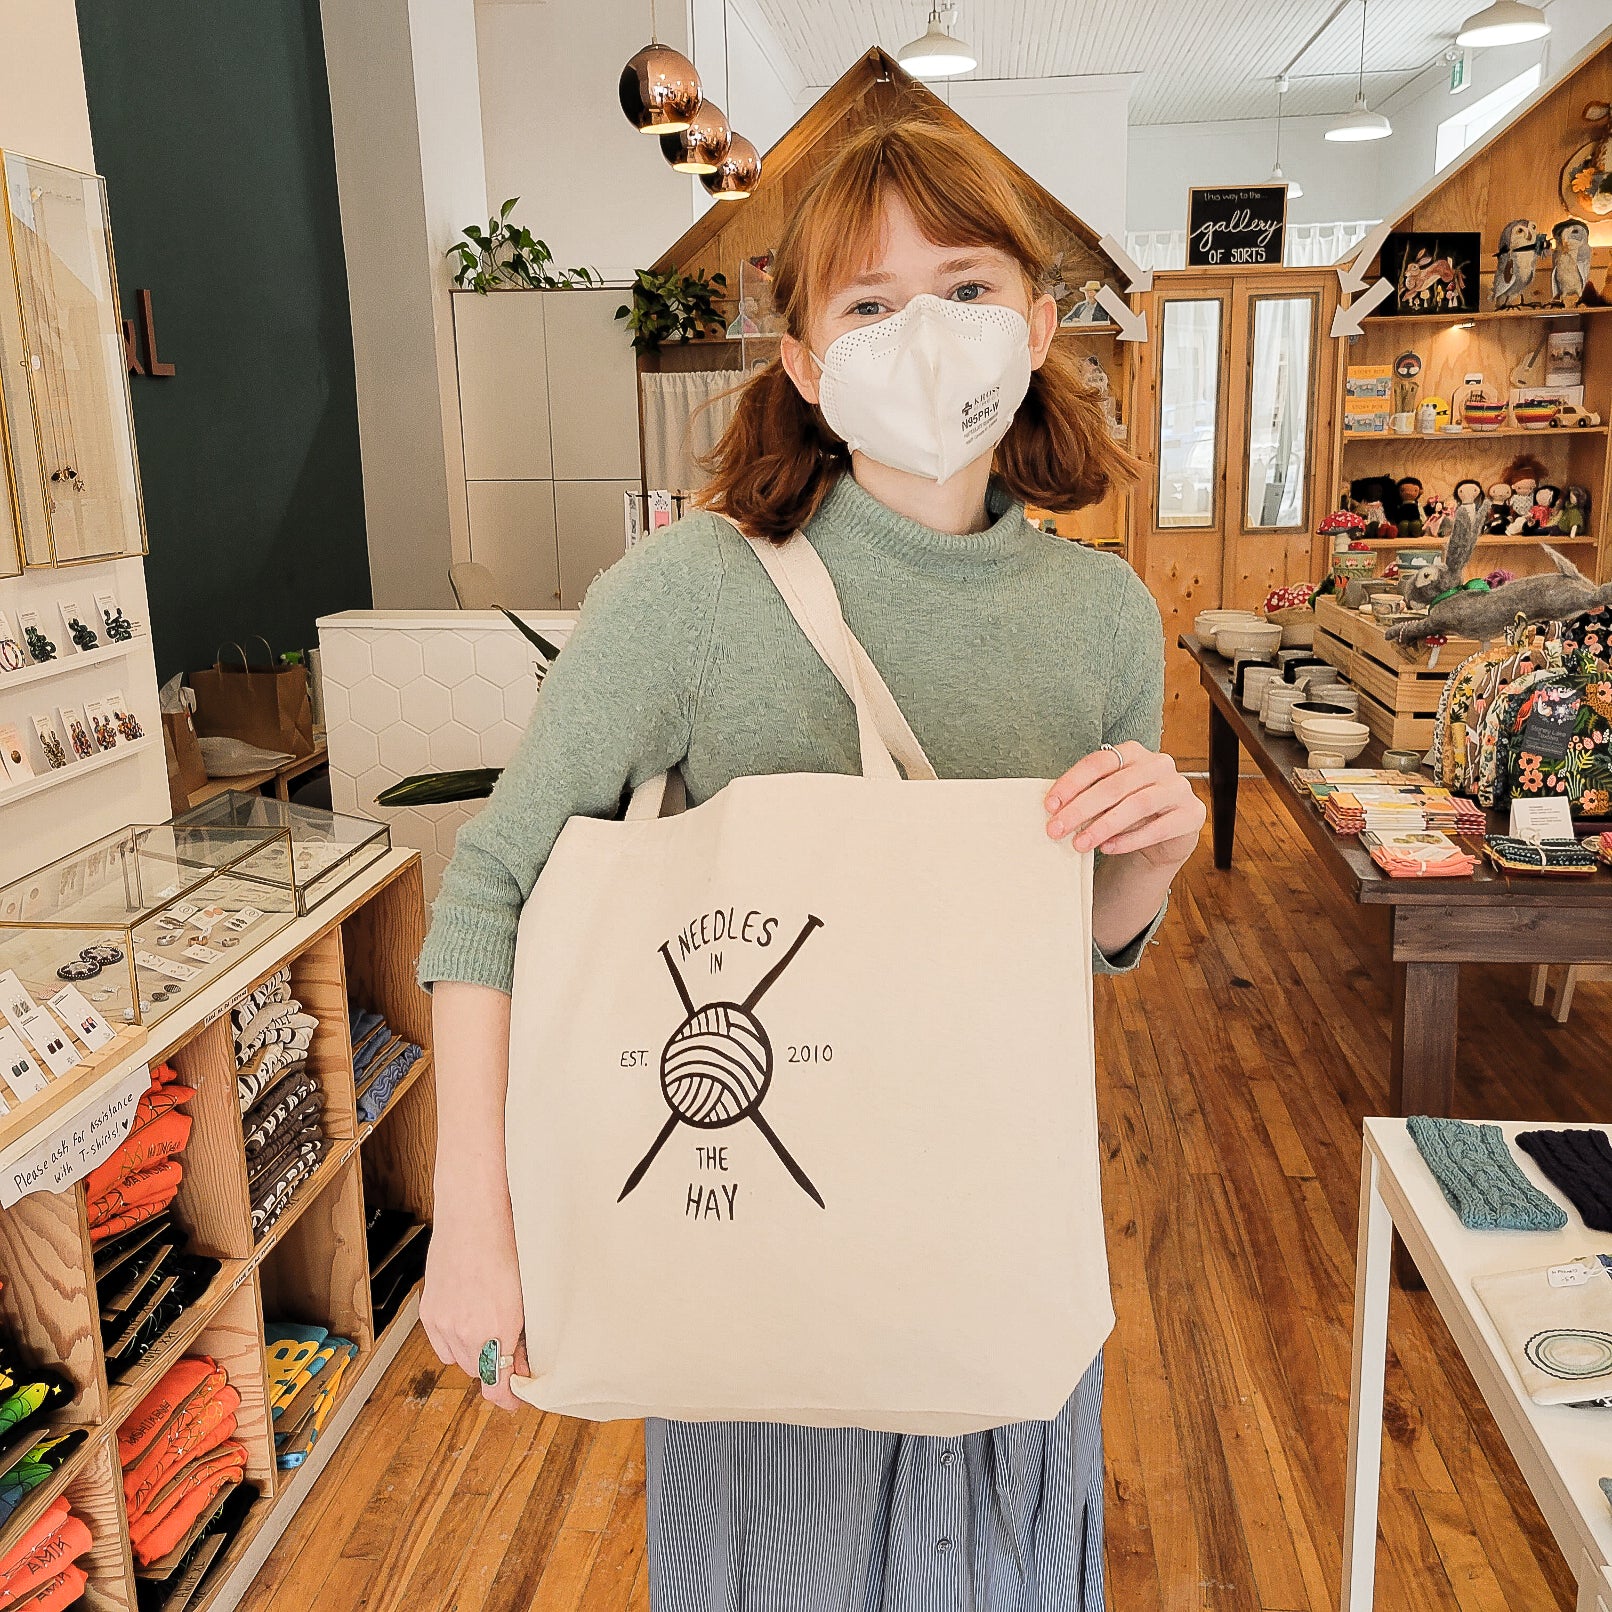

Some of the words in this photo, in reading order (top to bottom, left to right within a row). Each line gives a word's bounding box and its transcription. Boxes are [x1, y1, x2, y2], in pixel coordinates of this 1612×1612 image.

[1190, 208, 1283, 252] gallery
[1209, 249, 1225, 264] OF
[1230, 247, 1266, 263] SORTS
[678, 907, 779, 962] NEEDLES
[710, 951, 723, 975] IN
[620, 1050, 649, 1068] EST.
[787, 1045, 833, 1063] 2010
[13, 1160, 49, 1194] Please
[51, 1139, 70, 1164] ask
[73, 1130, 85, 1147] for
[695, 1146, 729, 1172] THE
[54, 1161, 73, 1184] with
[685, 1182, 738, 1222] HAY
